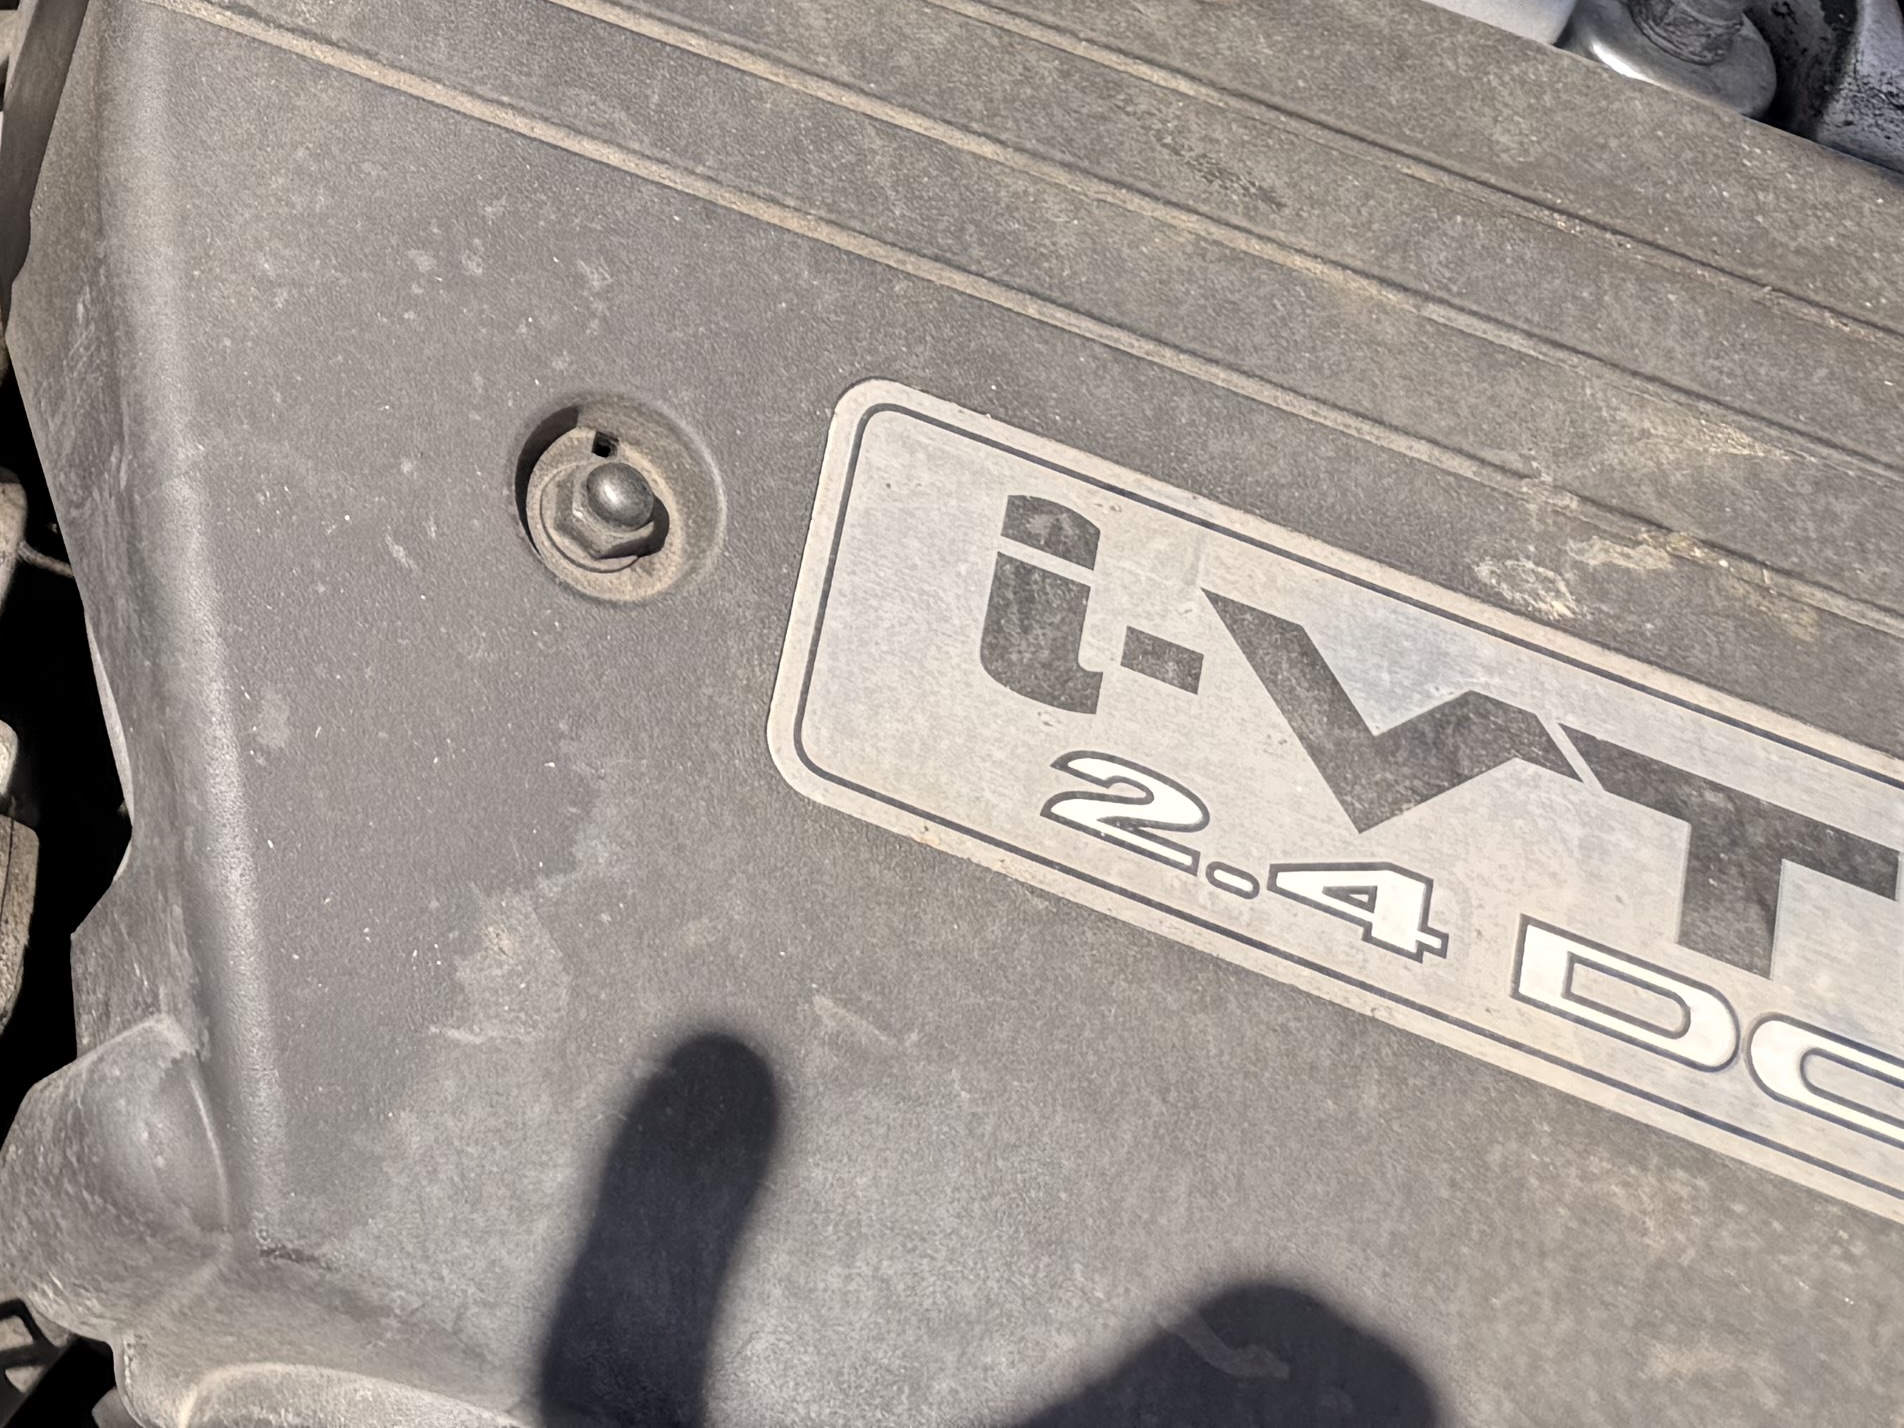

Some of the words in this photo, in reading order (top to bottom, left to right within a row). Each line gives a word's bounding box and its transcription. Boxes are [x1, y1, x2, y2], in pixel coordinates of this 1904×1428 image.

[978, 492, 1902, 982] i-VT
[1039, 750, 1449, 965] 2.4
[1509, 913, 1904, 1150] DO
